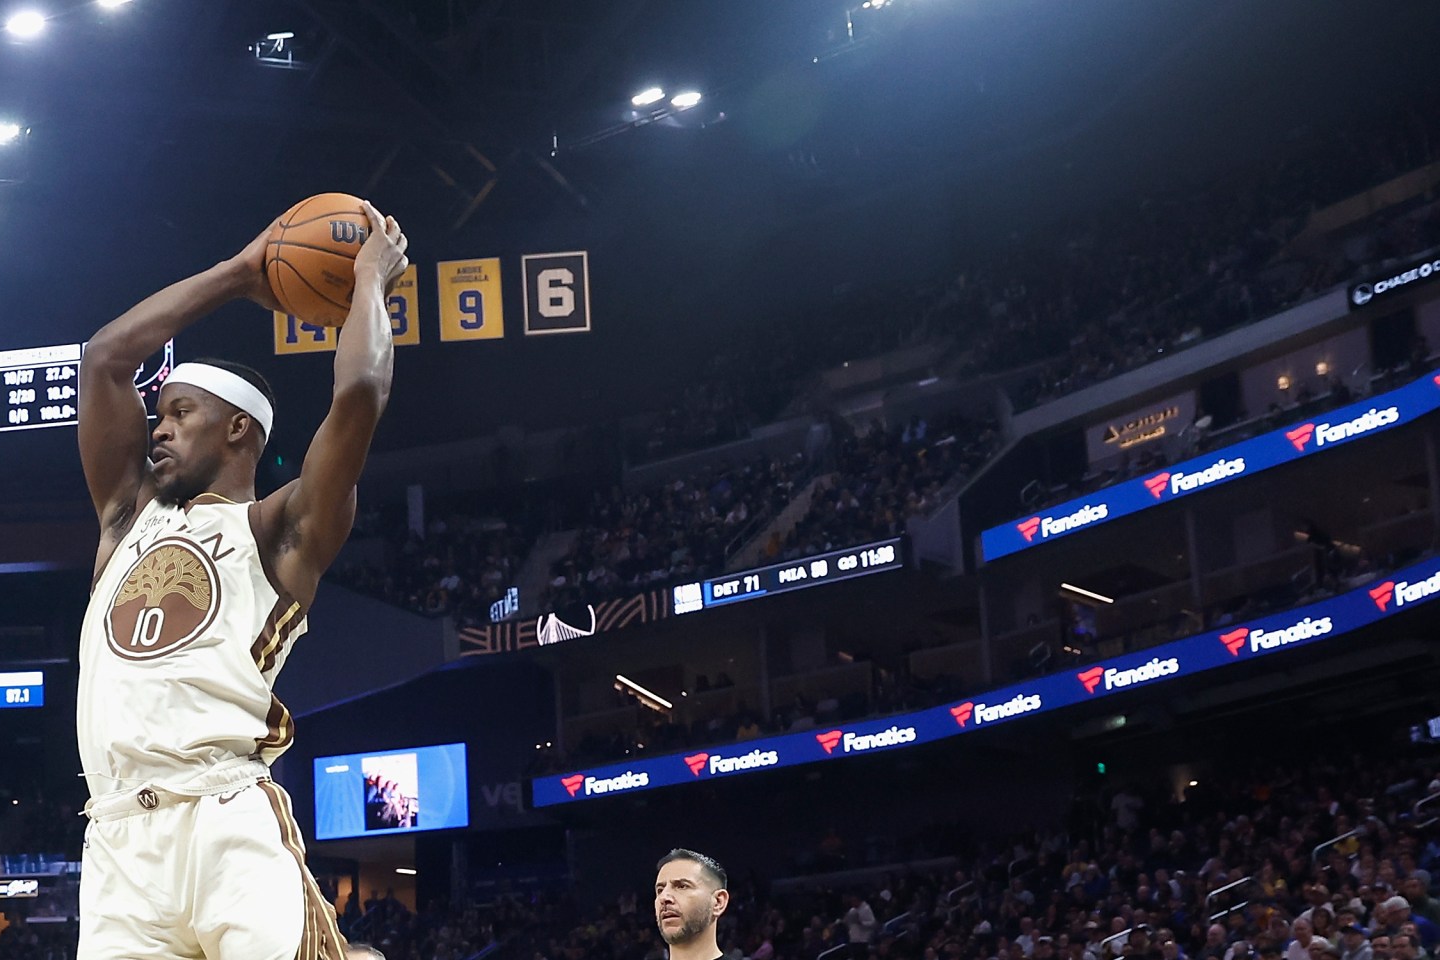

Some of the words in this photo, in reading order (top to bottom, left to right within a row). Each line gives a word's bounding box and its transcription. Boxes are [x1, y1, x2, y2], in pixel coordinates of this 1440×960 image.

[458, 290, 484, 330] 9
[537, 268, 575, 318] 6
[1315, 406, 1400, 446] Fanatics
[1171, 455, 1245, 495] Fanatics
[1041, 502, 1108, 538] Fanatics
[713, 580, 740, 598] DET
[744, 575, 760, 592] 71
[779, 566, 807, 583] MIA
[1394, 571, 1440, 607] Fana
[130, 607, 165, 647] 10
[1250, 615, 1333, 653] Fanatics
[1104, 657, 1179, 690] Fanatics
[974, 694, 1042, 724] Fanatics
[844, 724, 916, 753] Fanatics
[709, 747, 778, 776] Fanatics
[585, 769, 649, 796] Fanatics
